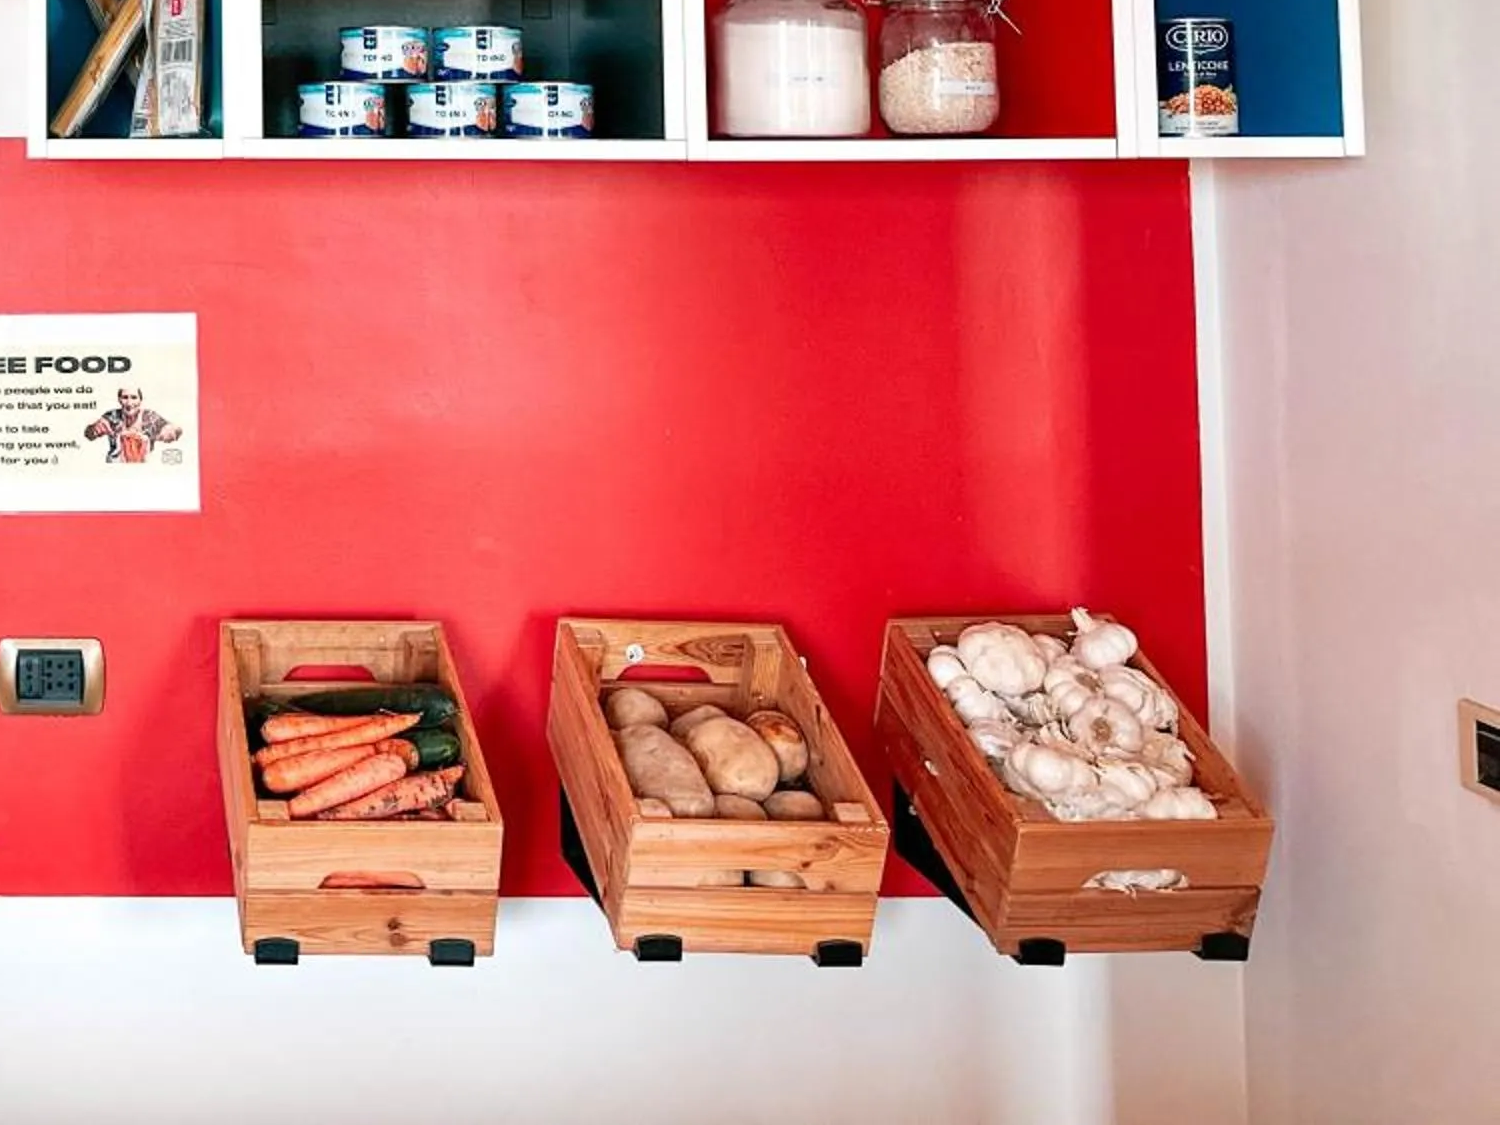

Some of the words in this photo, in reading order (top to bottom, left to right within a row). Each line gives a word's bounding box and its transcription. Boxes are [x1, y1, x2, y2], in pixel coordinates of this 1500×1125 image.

[34, 356, 132, 374] FOOD
[4, 385, 50, 396] people
[76, 385, 93, 394] do
[17, 402, 43, 410] that
[46, 403, 71, 412] you
[5, 425, 19, 434] to
[21, 425, 50, 434] take
[17, 442, 42, 451] you
[0, 456, 21, 464] for
[23, 458, 49, 466] you
